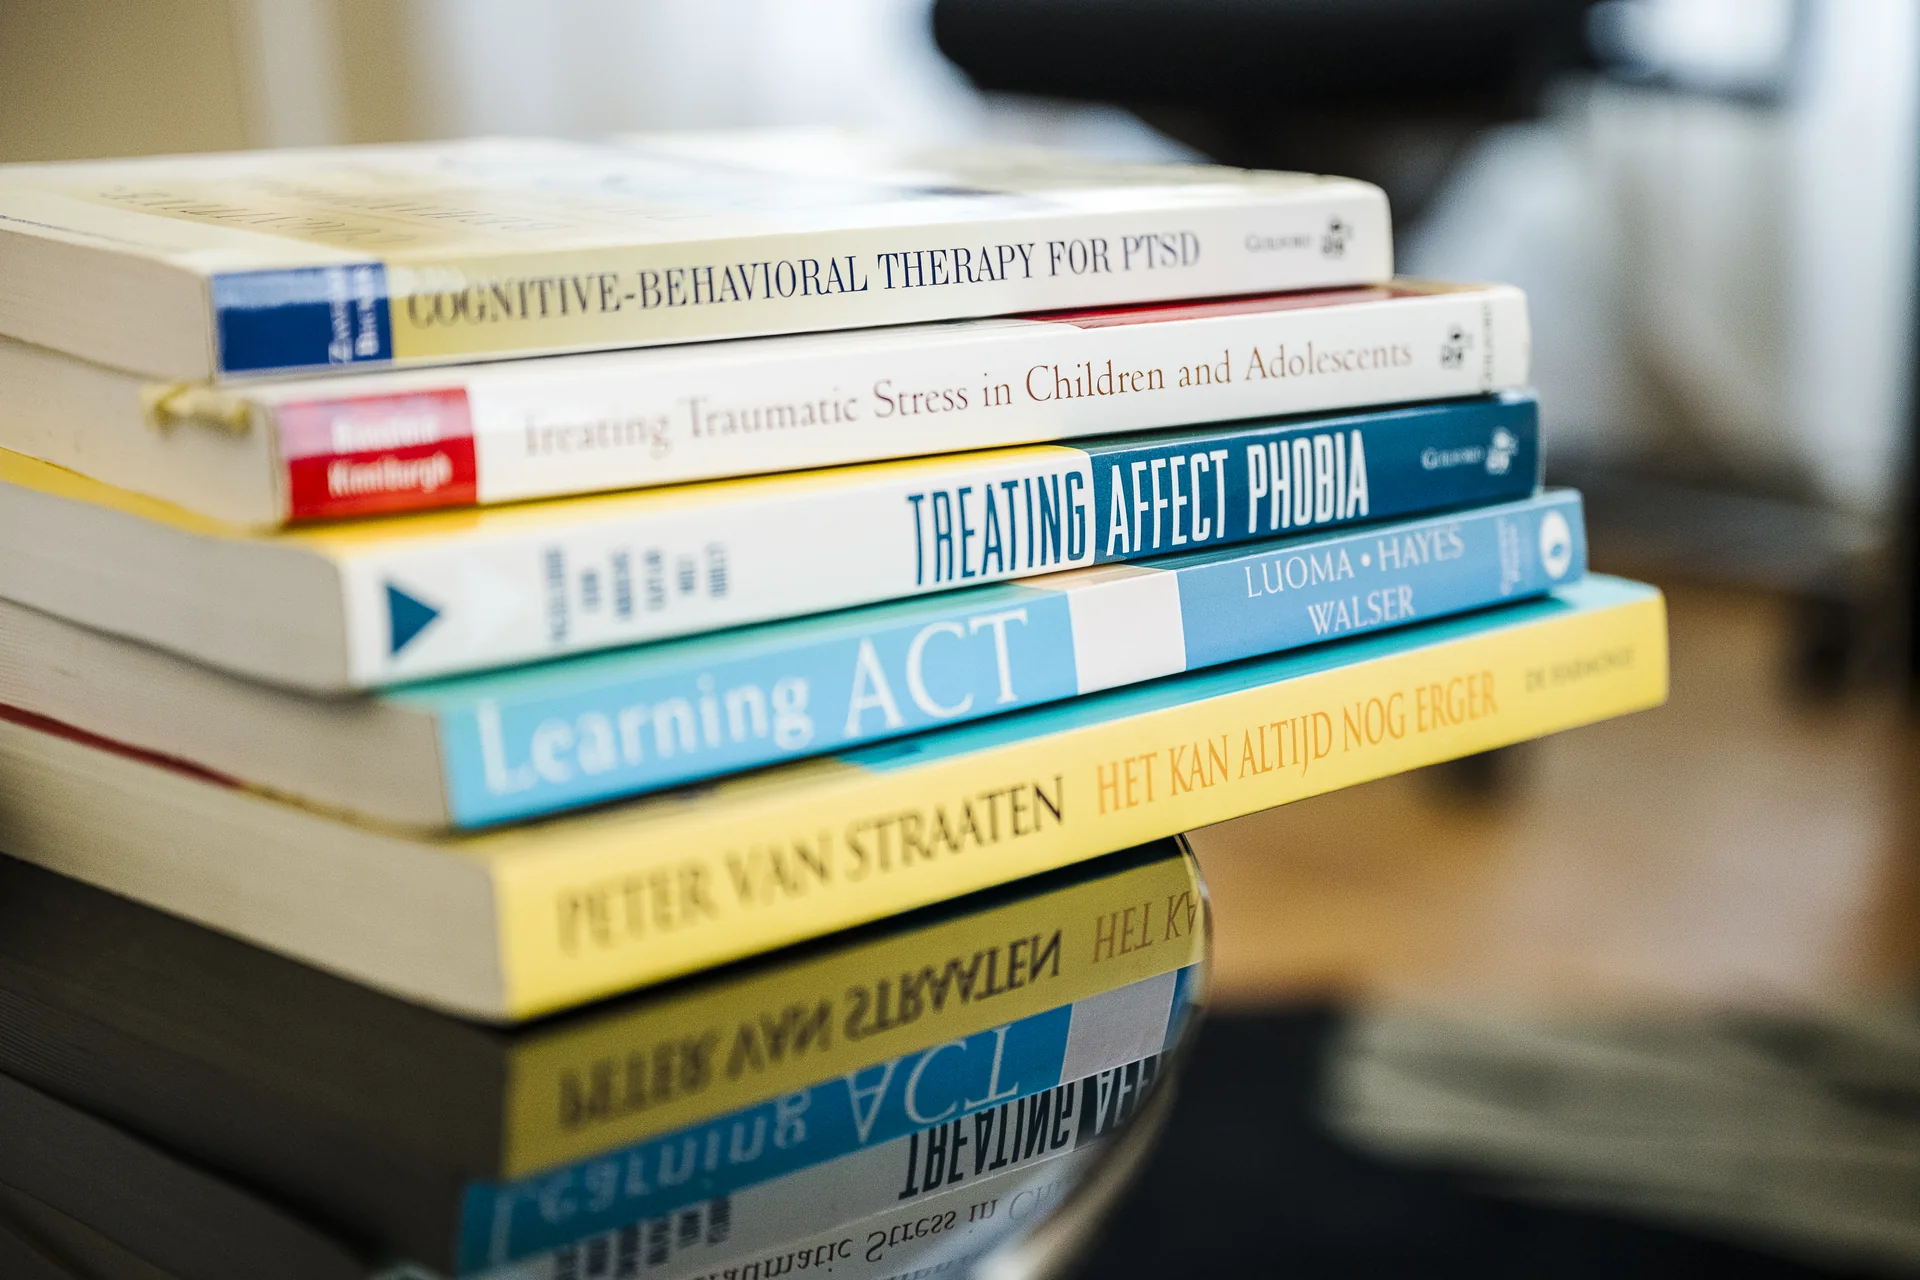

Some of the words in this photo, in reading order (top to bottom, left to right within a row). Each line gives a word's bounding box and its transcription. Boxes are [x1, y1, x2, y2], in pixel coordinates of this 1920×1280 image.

[407, 255, 870, 328] COGNITIVE-BEHAVIORAL
[877, 241, 1036, 290] THERAPY
[1048, 239, 1113, 276] FOR
[1119, 230, 1200, 271] PTSD
[681, 386, 858, 438] Traumatic
[872, 379, 969, 420] Stress
[983, 372, 1010, 407] in
[1025, 355, 1165, 402] Children
[1177, 350, 1231, 386] and
[1245, 341, 1414, 381] Adolescents
[906, 470, 1087, 588] TREATING
[1105, 448, 1230, 556] AFFECT
[1246, 429, 1370, 535] PHOBIA
[1244, 548, 1356, 600] LUOMA
[1377, 523, 1465, 575] HAYES
[1307, 586, 1416, 637] WALSER
[476, 674, 816, 794] Learning
[842, 608, 1029, 738] ACT
[1096, 752, 1157, 816] HET
[1168, 734, 1230, 796] KAN
[1238, 710, 1333, 779] ALTIJD
[1343, 691, 1407, 753] NOG
[1415, 669, 1500, 734] ERGER
[556, 862, 712, 956] PETER
[724, 836, 834, 912] VAN
[843, 774, 1065, 886] STRAATEN
